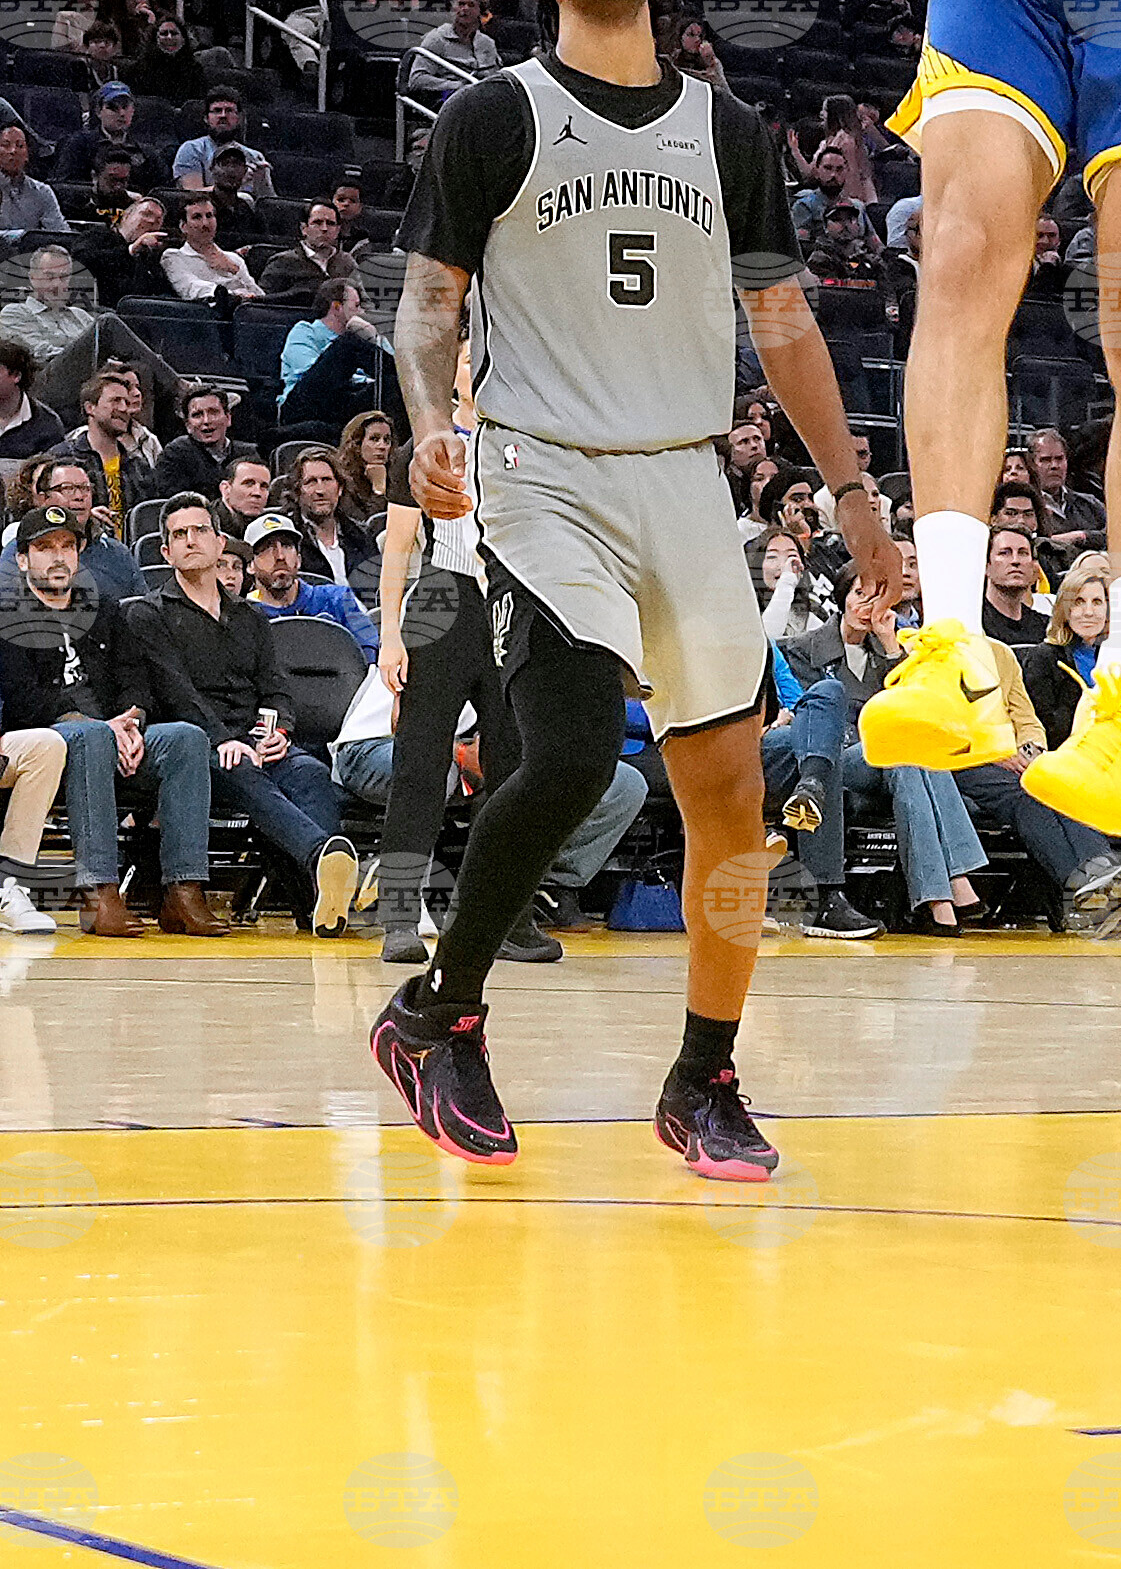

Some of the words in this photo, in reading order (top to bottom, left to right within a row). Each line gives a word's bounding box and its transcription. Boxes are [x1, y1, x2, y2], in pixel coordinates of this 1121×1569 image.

[537, 173, 594, 234] SAN
[601, 169, 715, 239] ANTONIO
[606, 229, 657, 309] 5
